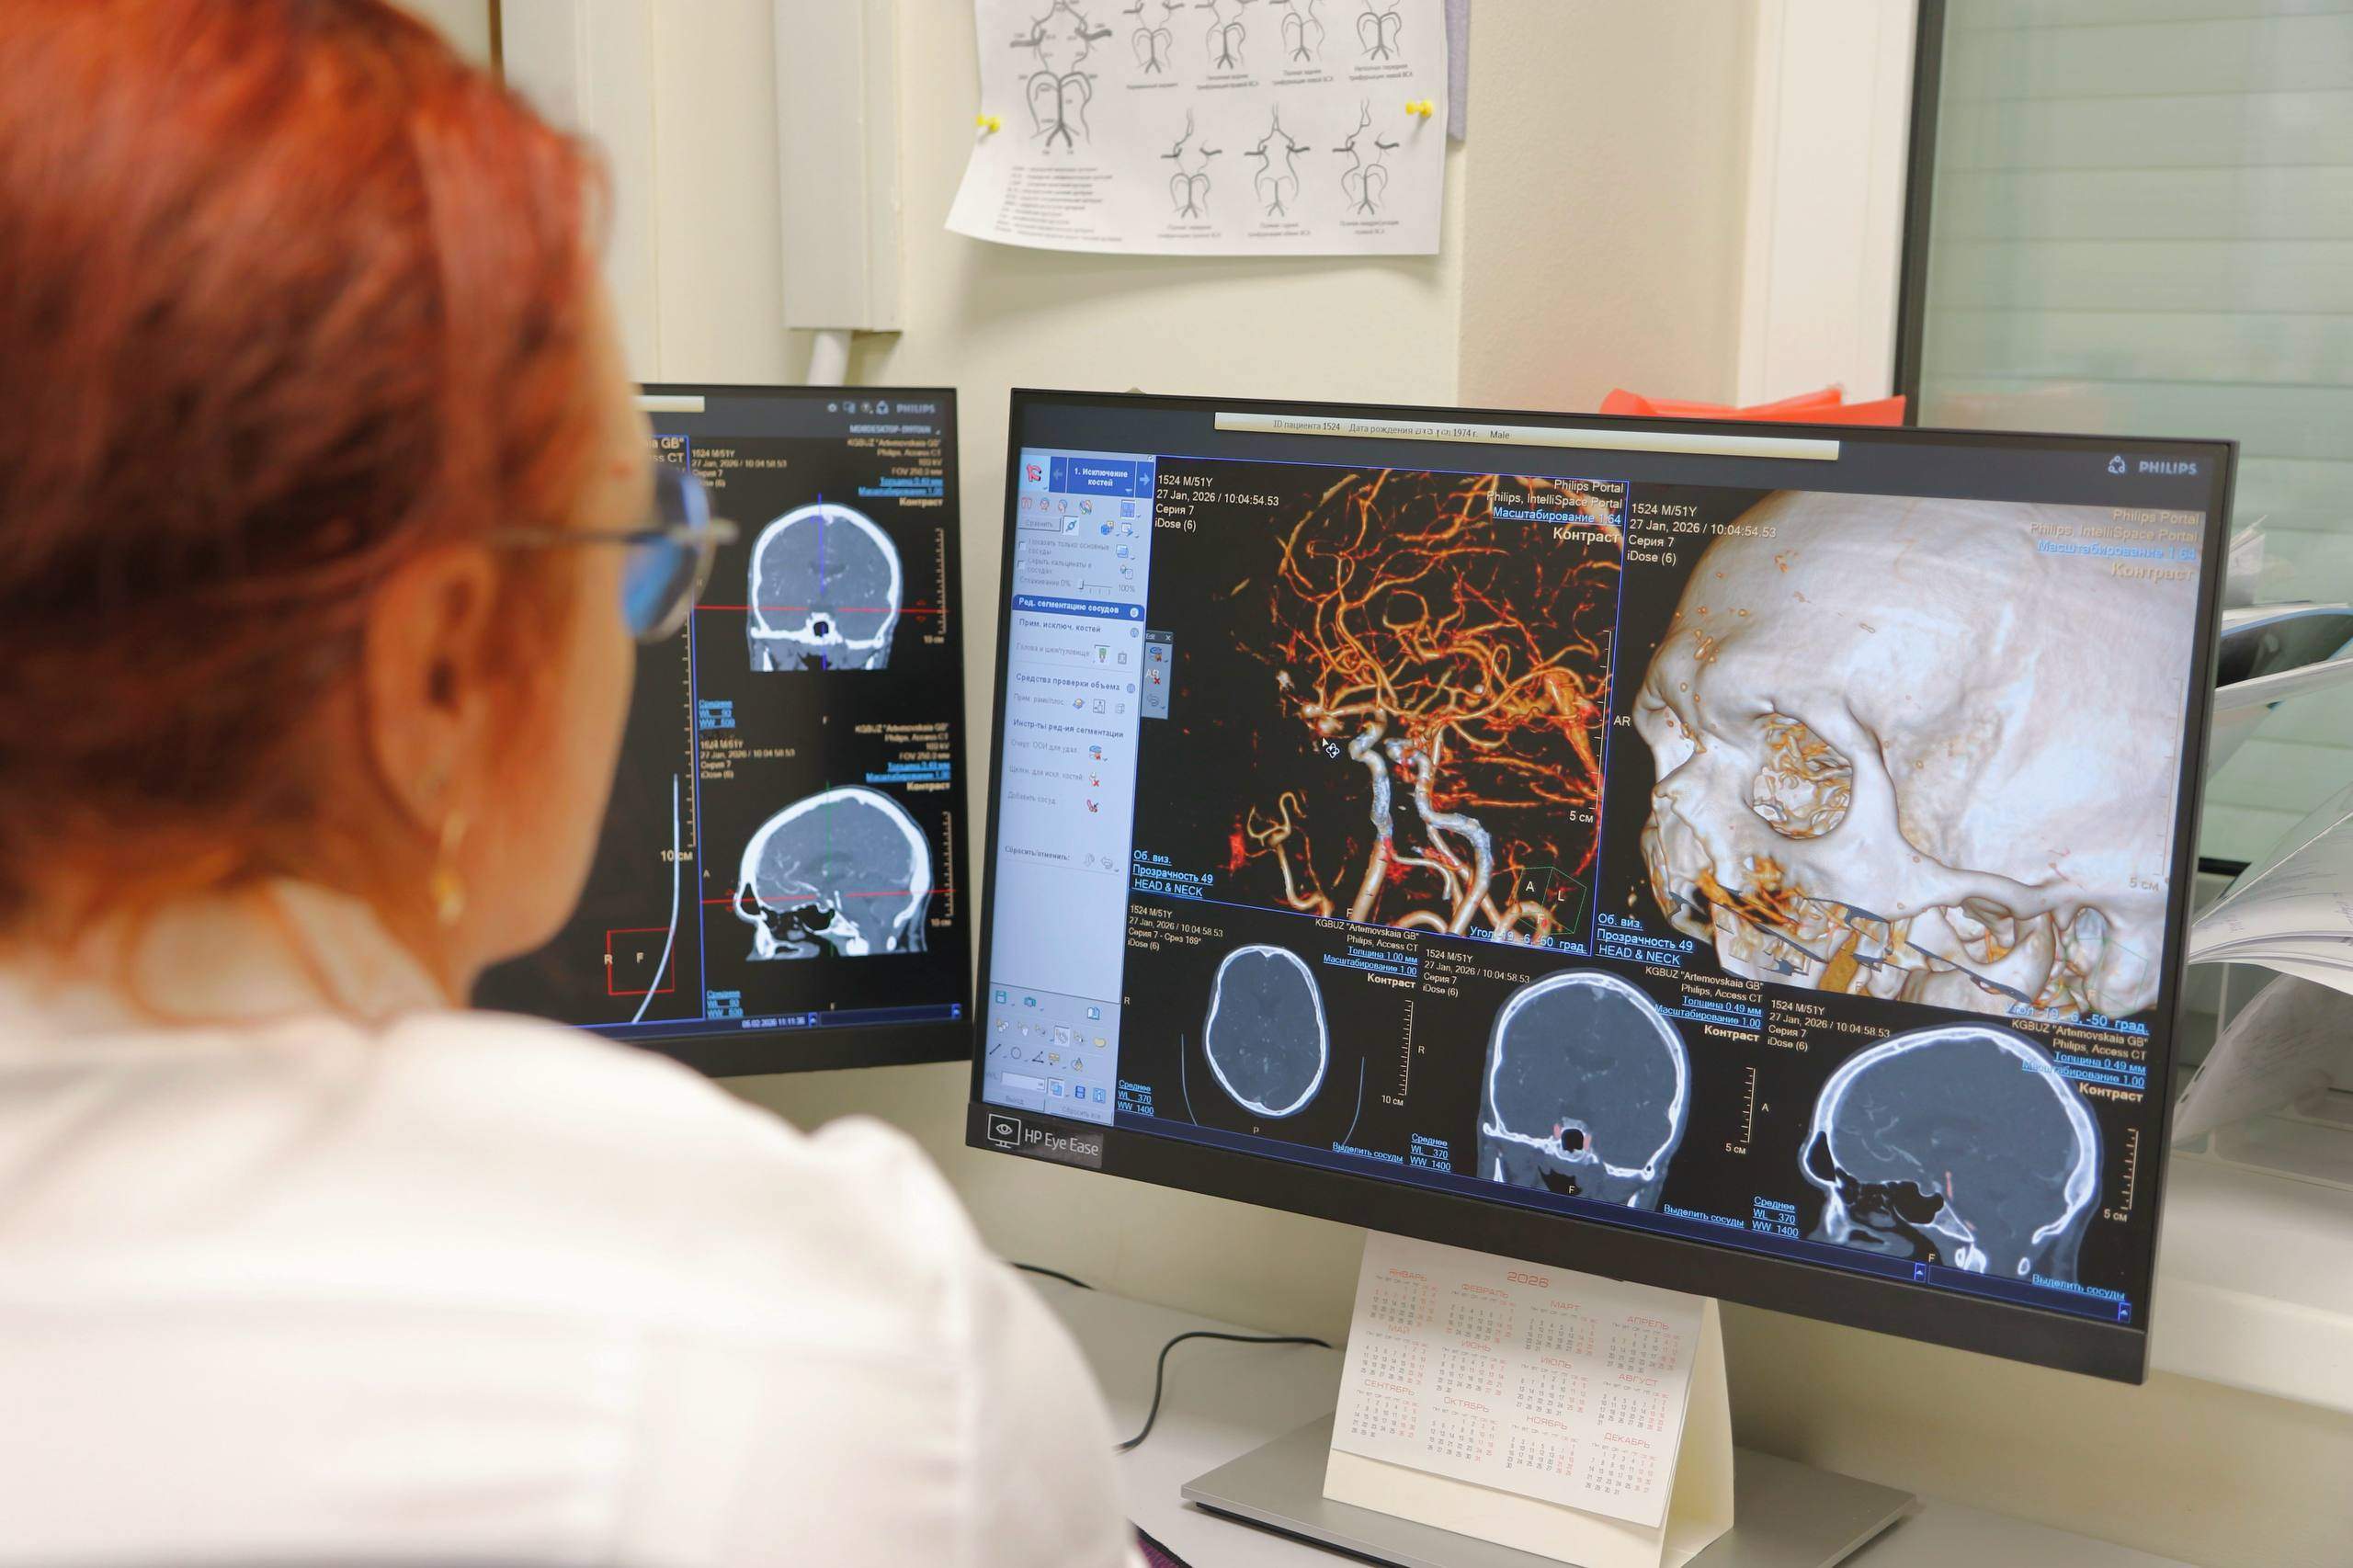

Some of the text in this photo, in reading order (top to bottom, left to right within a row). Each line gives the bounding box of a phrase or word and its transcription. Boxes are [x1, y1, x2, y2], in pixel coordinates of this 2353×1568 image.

[896, 404, 936, 414] PHILIPS
[1324, 423, 1340, 431] 1524
[1349, 424, 1369, 434] Дата
[1371, 426, 1413, 436] рождения
[1454, 429, 1471, 437] 1974
[1490, 430, 1510, 439] Male
[667, 452, 684, 462] CT
[1082, 468, 1128, 478] Исключение
[2139, 461, 2198, 475] PHILIPS
[1087, 478, 1114, 487] костей
[1158, 475, 1213, 487] 1524 M/51Y
[1554, 479, 1624, 495] Philips Portal
[899, 497, 943, 507] Контраст
[1156, 489, 1279, 506] 27 Jan, 2026 10:04:54.53
[1486, 490, 1623, 509] Philips, IntelliSpace Portal
[1155, 504, 1195, 517] Серия 7
[1493, 506, 1596, 524] Масштабирование
[1631, 504, 1698, 517] 1524 M/51Y
[2113, 510, 2200, 526] Philips Portal
[1154, 517, 1197, 533] iDose (6)
[1630, 519, 1777, 539] 27 Jan, 2026 10:04:54.53
[2080, 524, 2200, 541] IntelliSpace Portal
[1553, 527, 1620, 545] Контраст
[1629, 535, 1675, 550] Серия 7
[1627, 551, 1677, 566] iDose (6)
[2111, 562, 2194, 584] Контраст
[1119, 585, 1135, 594] 100%
[1018, 597, 1119, 615] Ред. сегментацию сосудов
[1019, 619, 1101, 634] Прим. исключ. костей
[1016, 673, 1120, 691] Средства проверки объема
[1013, 719, 1124, 739] Инстр-ты ред-ия сегментации
[1613, 715, 1631, 727] AR
[906, 782, 950, 792] Контраст
[1569, 810, 1576, 822] 5
[661, 850, 673, 861] 10
[1133, 849, 1172, 865] Об. виз.
[1132, 864, 1213, 884] Прозрачность 49
[1134, 879, 1204, 897] HEAD & NECK
[1525, 881, 1535, 892] A
[1130, 904, 1148, 916] 1524
[1129, 916, 1175, 931] 27 2026
[1315, 918, 1345, 930] KGBUZ
[1598, 913, 1643, 929] Об. виз.
[1128, 926, 1184, 944] Серия 7 Срез
[1597, 928, 1694, 952] Прозрачность 49
[1128, 940, 1160, 951] iDose (6)
[1347, 946, 1384, 959] Толщина
[1377, 939, 1419, 952] Access CT
[1559, 940, 1587, 954] град.
[604, 954, 613, 964] R
[636, 952, 644, 963] F
[1427, 949, 1473, 964] 1524 M/51Y
[1599, 943, 1680, 965] HEAD & NECK
[1324, 954, 1398, 972] Масштабирование
[1425, 960, 1476, 976] 27 2026
[1368, 972, 1416, 989] Контраст
[1424, 972, 1458, 985] Серия 7
[1645, 966, 1744, 989] KGBUZ "Artemovskaia
[1423, 984, 1459, 998] iDose (6)
[1681, 983, 1763, 1004] Philips, Access CT
[1683, 995, 1723, 1010] Толщина
[1771, 1000, 1825, 1016] 1524 M/51Y
[1654, 1003, 1739, 1025] Масштабирование
[1768, 1012, 1827, 1029] 27 Jan, 2026
[1704, 1024, 1759, 1042] Контраст
[1768, 1025, 1807, 1039] Серия 7
[2012, 1018, 2050, 1034] KGBUZ
[2114, 1020, 2150, 1035] град.
[1768, 1037, 1808, 1053] iDose (6)
[2092, 1044, 2148, 1061] Access CT
[2055, 1051, 2101, 1068] Толщина
[1138, 1094, 1152, 1104] 370
[1381, 1095, 1392, 1105] 10
[2079, 1082, 2143, 1103] Контраст
[1137, 1104, 1154, 1115] 1400
[1024, 1129, 1098, 1156] HP Eye Ease
[1332, 1142, 1404, 1164] Выделить сосуды
[1410, 1144, 1449, 1159] WL 370
[1410, 1156, 1451, 1171] WW 1400
[1568, 1185, 1575, 1194] F
[1753, 1196, 1795, 1211] Среднее
[1664, 1203, 1745, 1228] Выделить сосуды
[1752, 1208, 1795, 1224] WL 370
[1751, 1220, 1799, 1236] WW 1400
[1389, 1268, 1427, 1282] ЯНВАРЬ
[1507, 1271, 1550, 1288] 2026
[1461, 1283, 1509, 1299] ФЕВРАЛЬ
[2032, 1274, 2125, 1301] Выделить сосуды
[1551, 1301, 1581, 1311] МАРТ
[1626, 1316, 1669, 1330] АПРЕЛЬ
[1461, 1339, 1492, 1352] ИЮНЬ
[1540, 1356, 1572, 1369] ИЮЛЬ
[1364, 1379, 1415, 1396] СЕНТЯБРЬ
[1619, 1373, 1658, 1387] АВГУСТ
[1444, 1395, 1490, 1413] ОКТЯБРЬ
[1527, 1415, 1568, 1431] НОЯБРЬ
[1604, 1432, 1651, 1449] ДЕКАБРЬ
